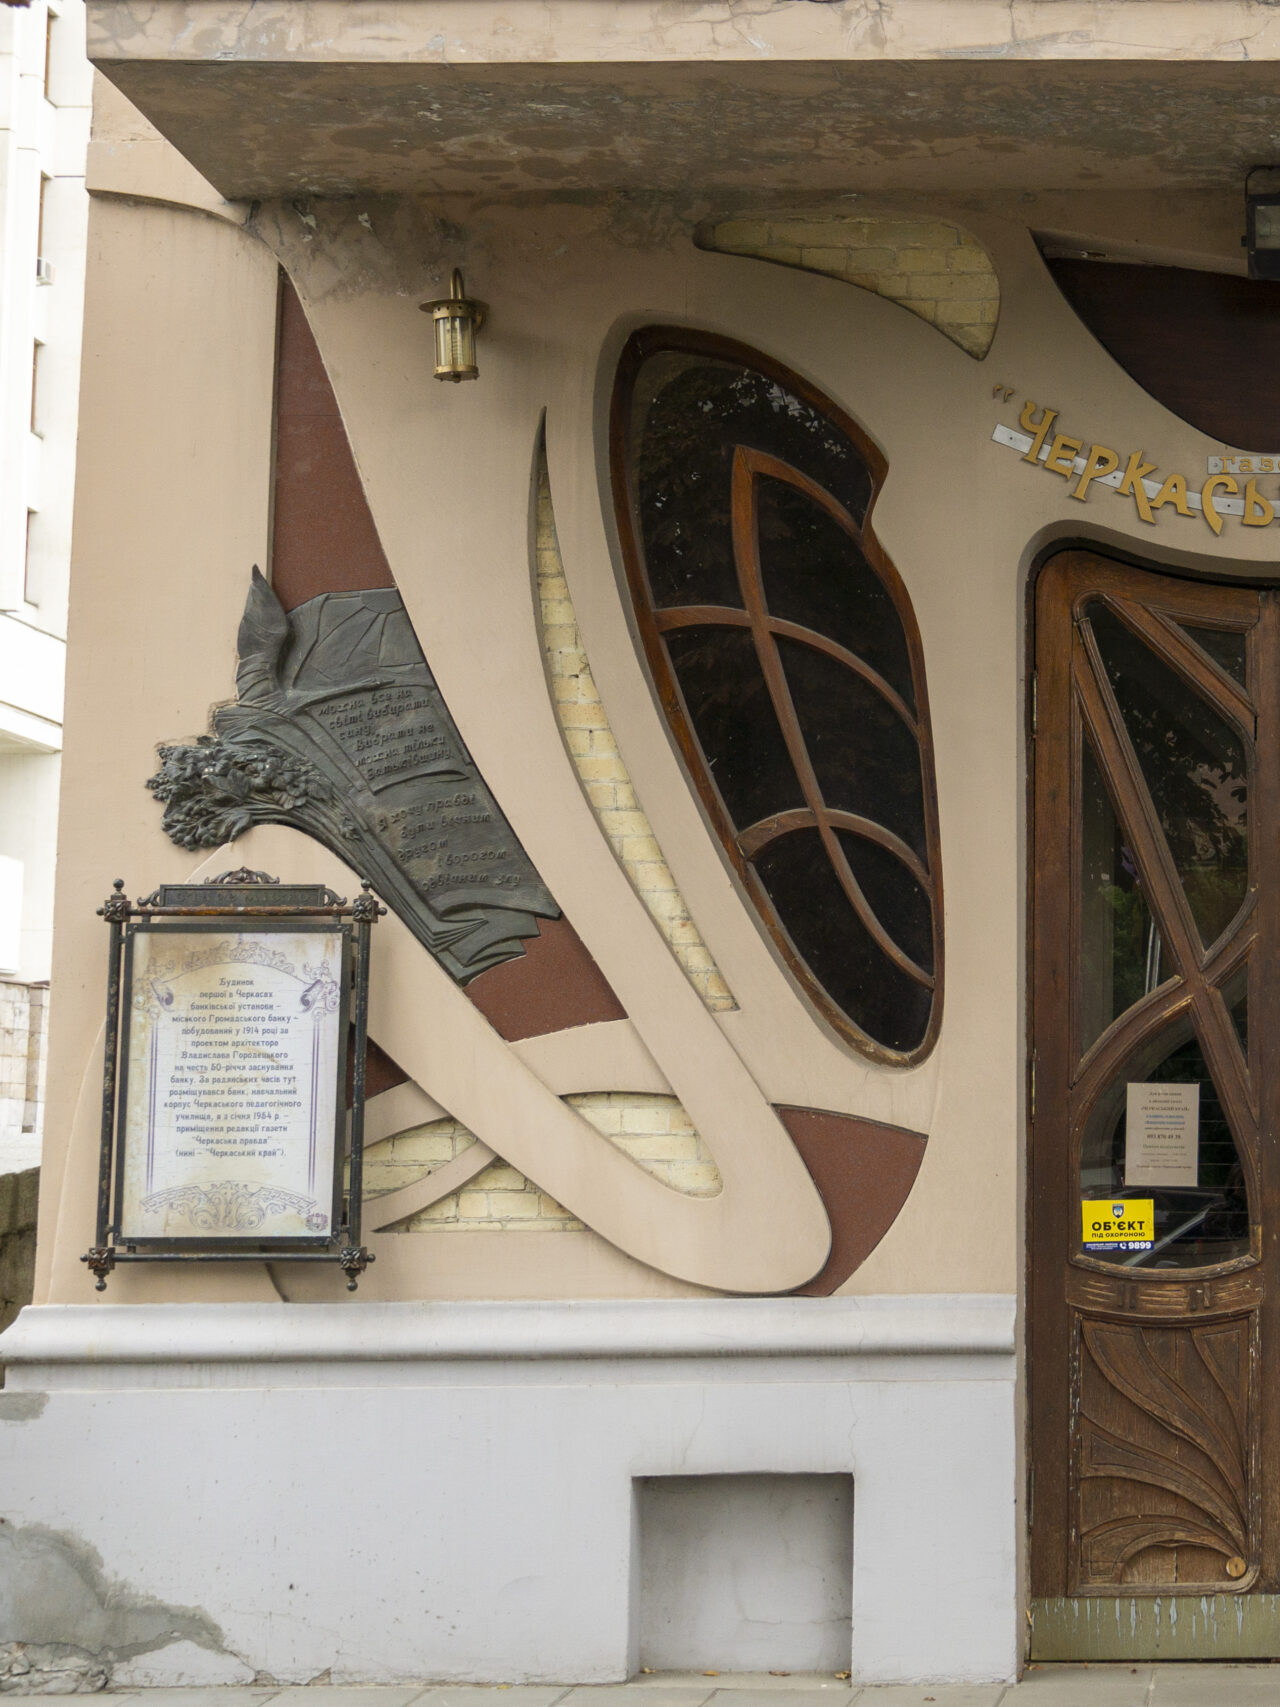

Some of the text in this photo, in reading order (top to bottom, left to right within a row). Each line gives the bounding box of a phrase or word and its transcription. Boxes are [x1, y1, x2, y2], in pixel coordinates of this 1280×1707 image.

[219, 978, 254, 986] Будинок
[200, 991, 226, 999] першої
[236, 989, 272, 999] Черкасах
[238, 1004, 273, 1012] установи
[209, 1015, 265, 1024] Громадського
[268, 1014, 291, 1024] банку
[182, 1027, 232, 1036] побудований
[262, 1028, 277, 1036] році
[232, 1040, 278, 1048] архітектора
[181, 1051, 288, 1060] Владислава Городецького
[249, 1064, 293, 1072] заснування
[212, 1076, 258, 1084] радянських
[283, 1076, 296, 1084] тут
[169, 1089, 224, 1097] розміщувався
[164, 1099, 302, 1109] корпус Черкаського педагогічного
[226, 1125, 259, 1133] редакції
